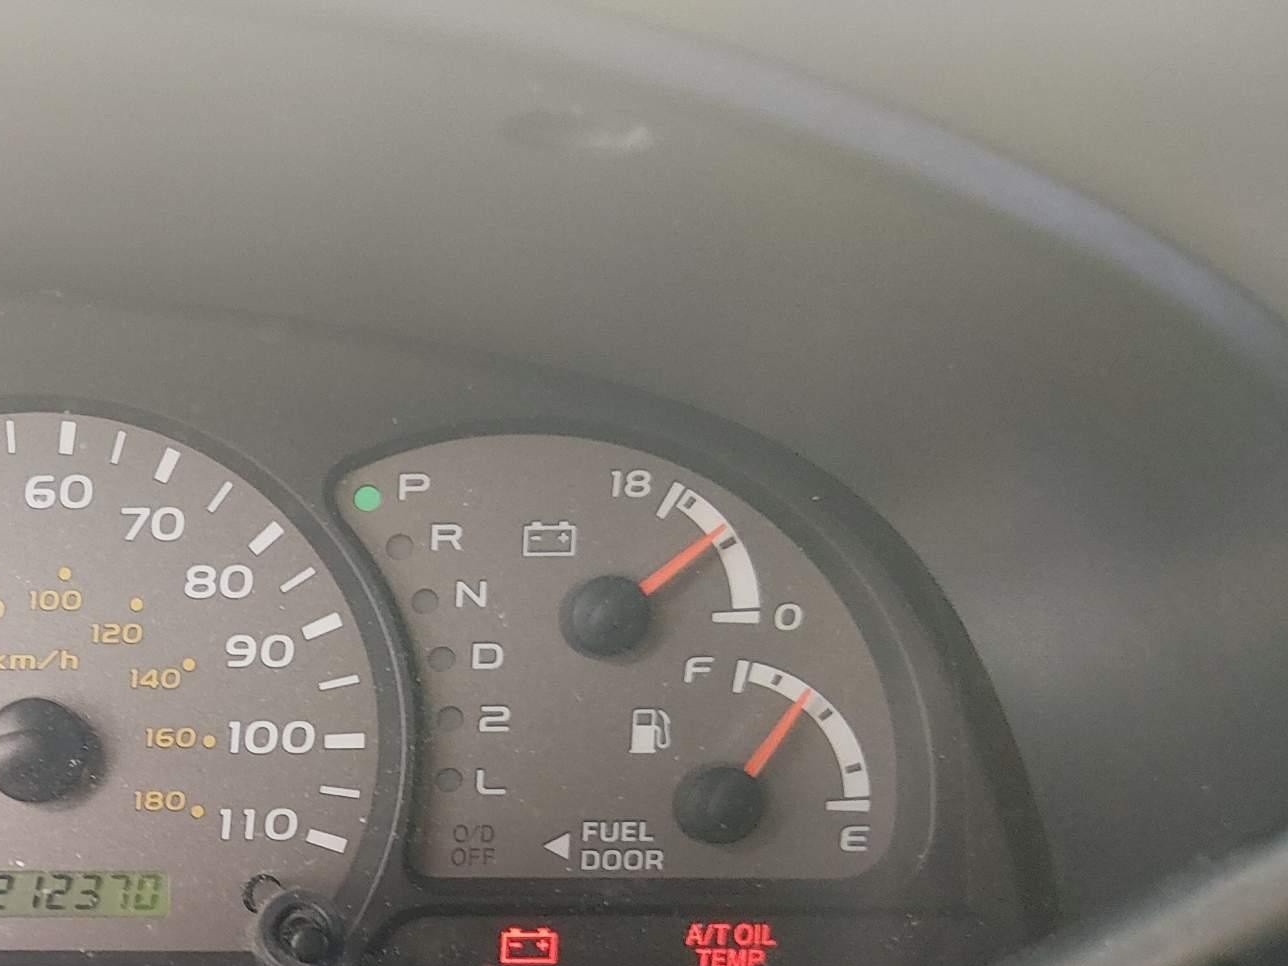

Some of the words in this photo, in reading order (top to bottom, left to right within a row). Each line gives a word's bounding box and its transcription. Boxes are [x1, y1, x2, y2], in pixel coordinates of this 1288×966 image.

[24, 474, 93, 511] 60
[398, 473, 431, 501] P
[611, 469, 652, 500] 18
[120, 506, 186, 542] 70
[430, 524, 463, 552] R
[183, 564, 255, 600] 80
[455, 580, 488, 608] N
[28, 590, 82, 612] 100
[773, 603, 803, 631] 0
[90, 623, 143, 644] 120
[224, 634, 295, 670] 90
[472, 643, 505, 670] D
[129, 667, 181, 690] 140
[683, 656, 715, 683] F
[478, 706, 512, 733] 2
[145, 727, 197, 749] 160
[227, 719, 316, 756] 100
[475, 769, 506, 796] L
[134, 790, 186, 812] 180
[218, 806, 298, 842] 110
[452, 823, 495, 844] O/D
[581, 820, 655, 844] FUEL
[840, 825, 871, 852] E
[450, 847, 497, 868] OFF
[580, 849, 664, 872] DOOR
[685, 923, 731, 946] A/T
[733, 922, 777, 947] OIL
